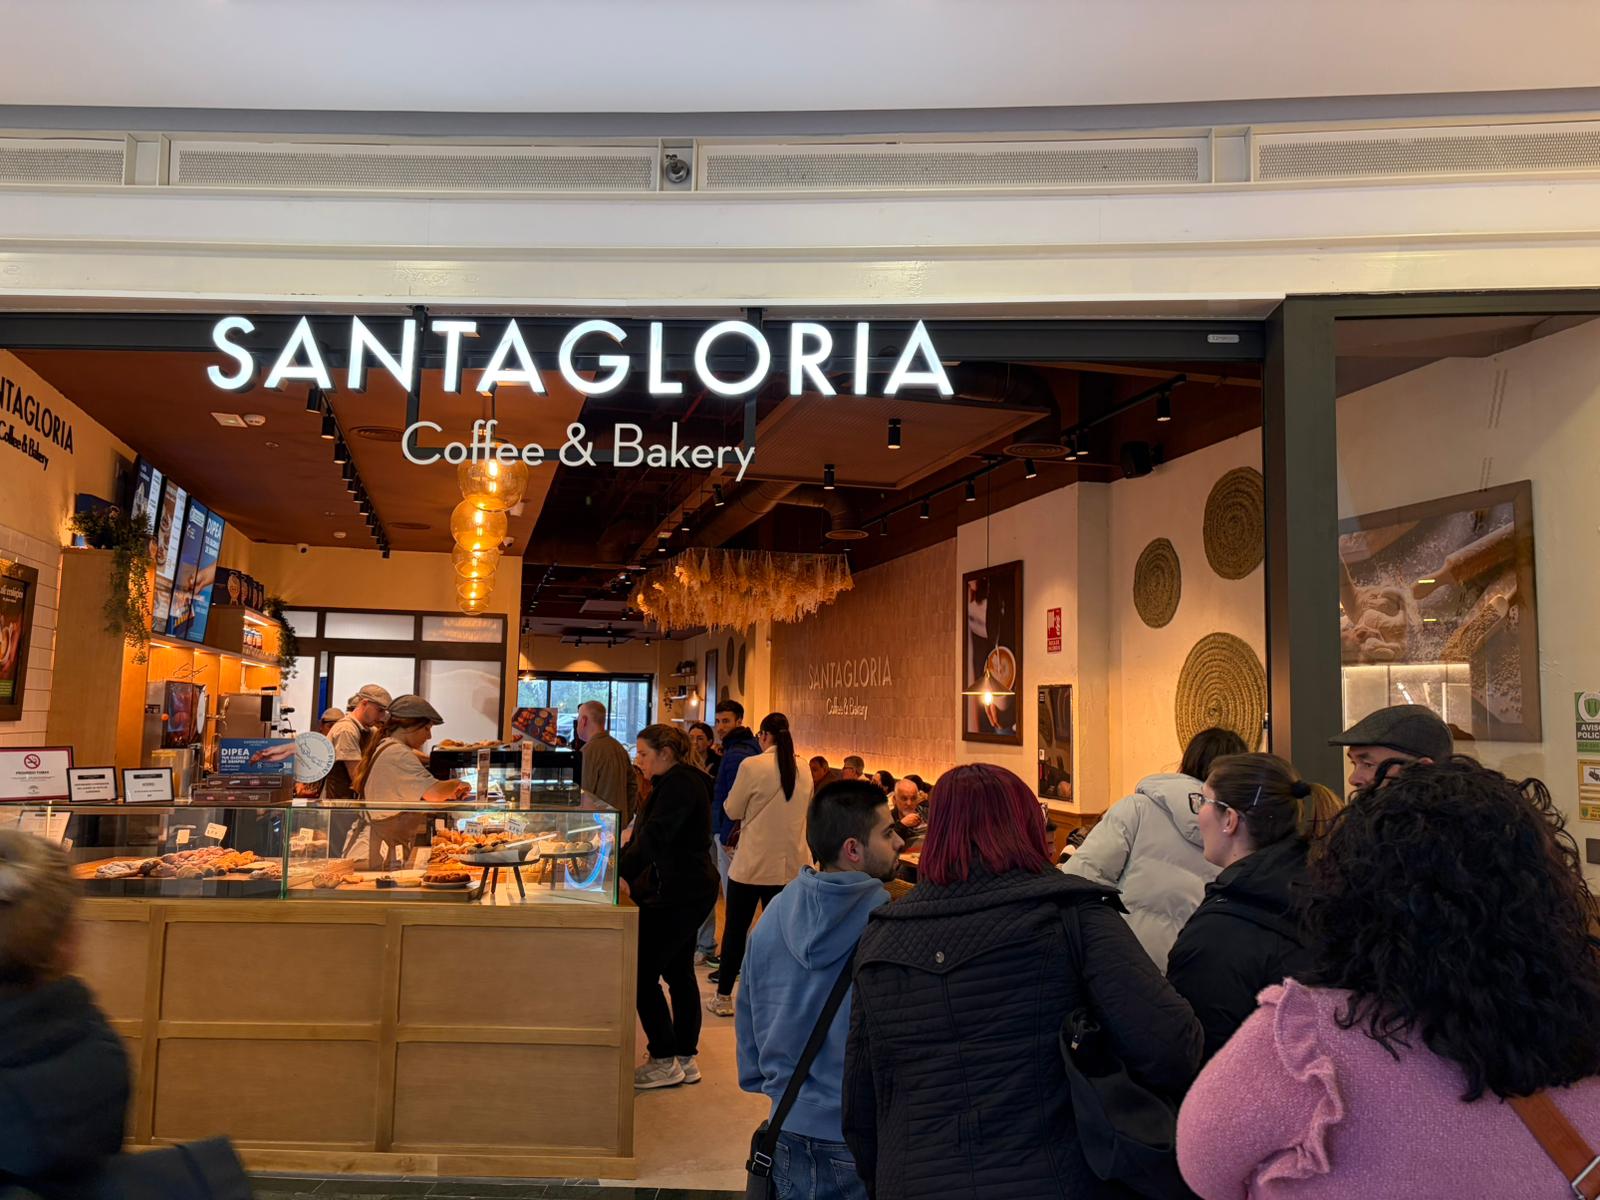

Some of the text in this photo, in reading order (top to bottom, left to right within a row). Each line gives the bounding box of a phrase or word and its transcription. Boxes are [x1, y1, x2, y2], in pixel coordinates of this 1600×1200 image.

[207, 315, 955, 397] SANTAGLORIA
[21, 434, 28, 454] &
[402, 419, 756, 482] Coffee & Bakery
[808, 655, 893, 691] SANTAGLORIA
[843, 697, 850, 715] &
[221, 748, 250, 756] DIPEA
